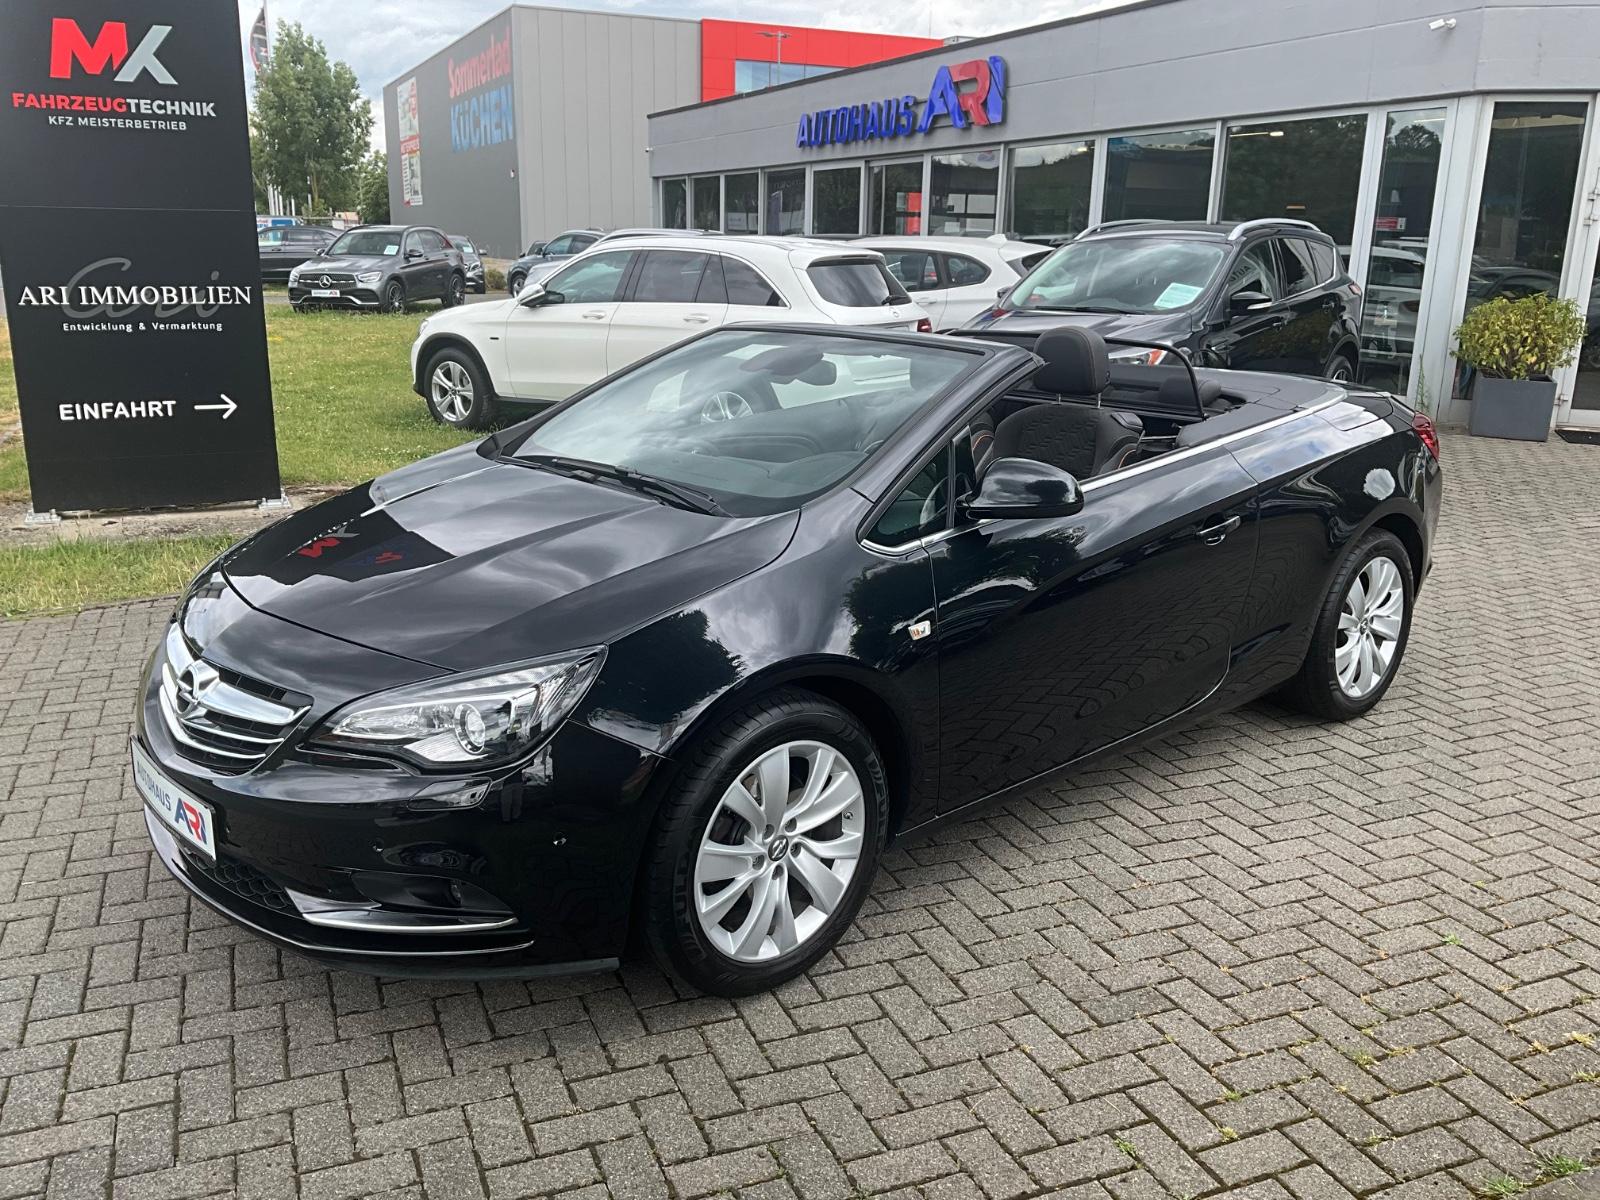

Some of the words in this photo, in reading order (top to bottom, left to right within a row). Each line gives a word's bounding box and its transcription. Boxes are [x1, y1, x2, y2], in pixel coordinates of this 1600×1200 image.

[50, 18, 178, 85] MK
[447, 26, 512, 99] Sommerlad
[12, 92, 216, 117] FAHRZEUGTECHNIK
[48, 115, 74, 127] KFZ
[78, 117, 187, 131] MEISTERBETRIEB
[450, 84, 514, 152] KÜCHEN
[796, 95, 917, 148] AUTOHAUS
[917, 56, 1007, 134] ARI
[18, 286, 70, 306] ARI
[79, 286, 251, 305] IMMOBILIEN
[63, 322, 133, 333] Entwicklung
[138, 322, 146, 331] &
[152, 321, 223, 332] Vermarktung
[58, 400, 177, 421] EINFAHRT
[136, 760, 172, 812] AUTOHAUS
[174, 797, 208, 845] ARI
